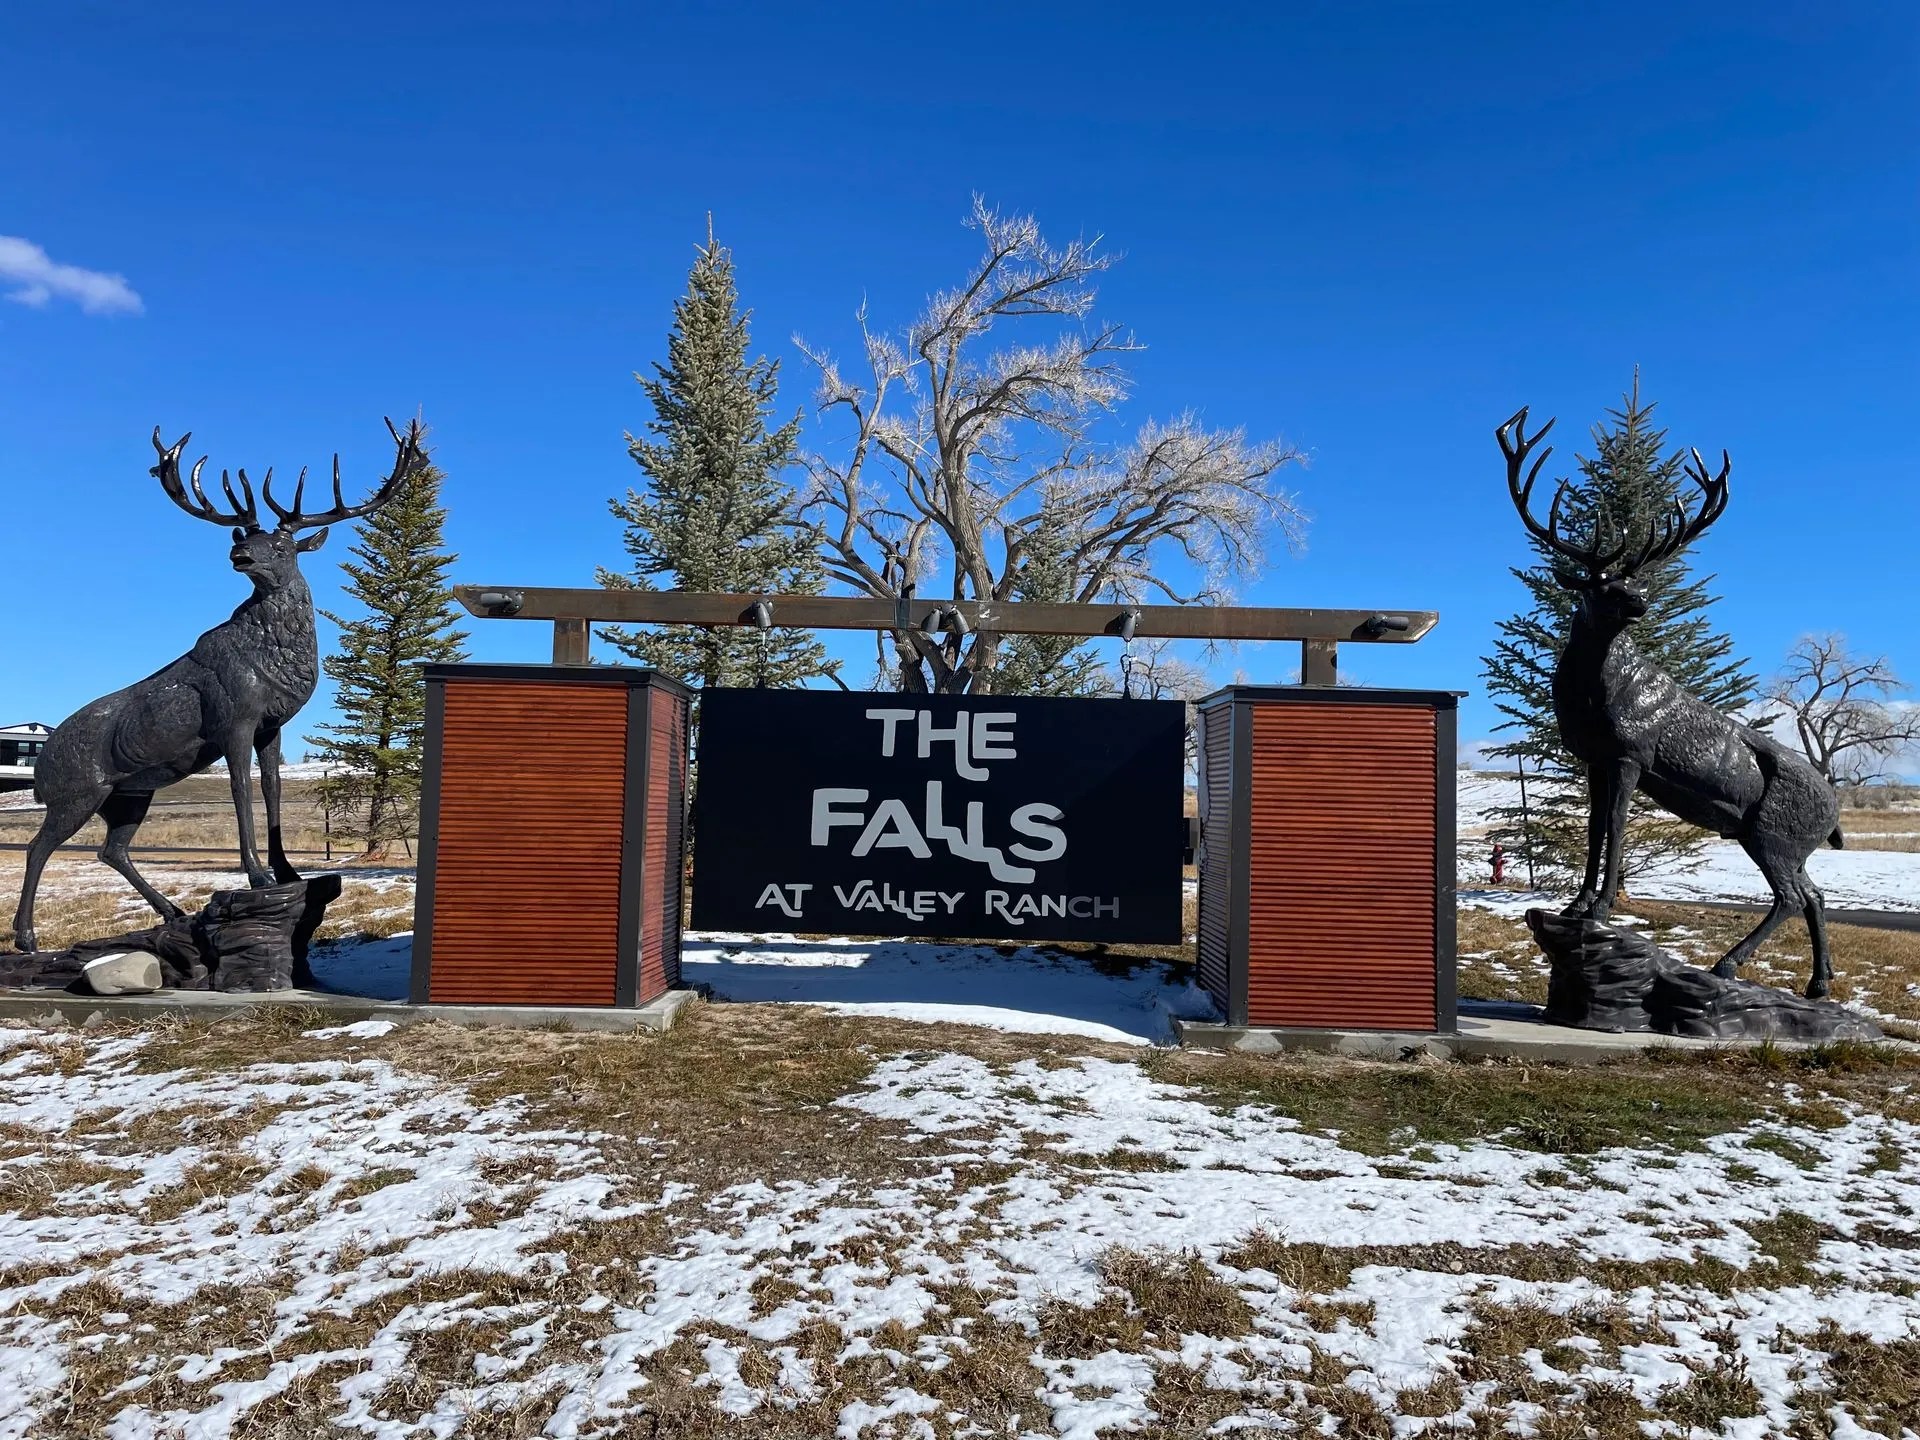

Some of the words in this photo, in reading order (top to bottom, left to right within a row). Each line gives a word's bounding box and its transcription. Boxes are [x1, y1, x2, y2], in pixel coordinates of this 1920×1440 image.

[866, 708, 1017, 782] THE
[810, 780, 1068, 884] FALLS
[754, 883, 813, 918] AT
[833, 879, 966, 921] VALLEY
[985, 889, 1120, 926] RANCH
